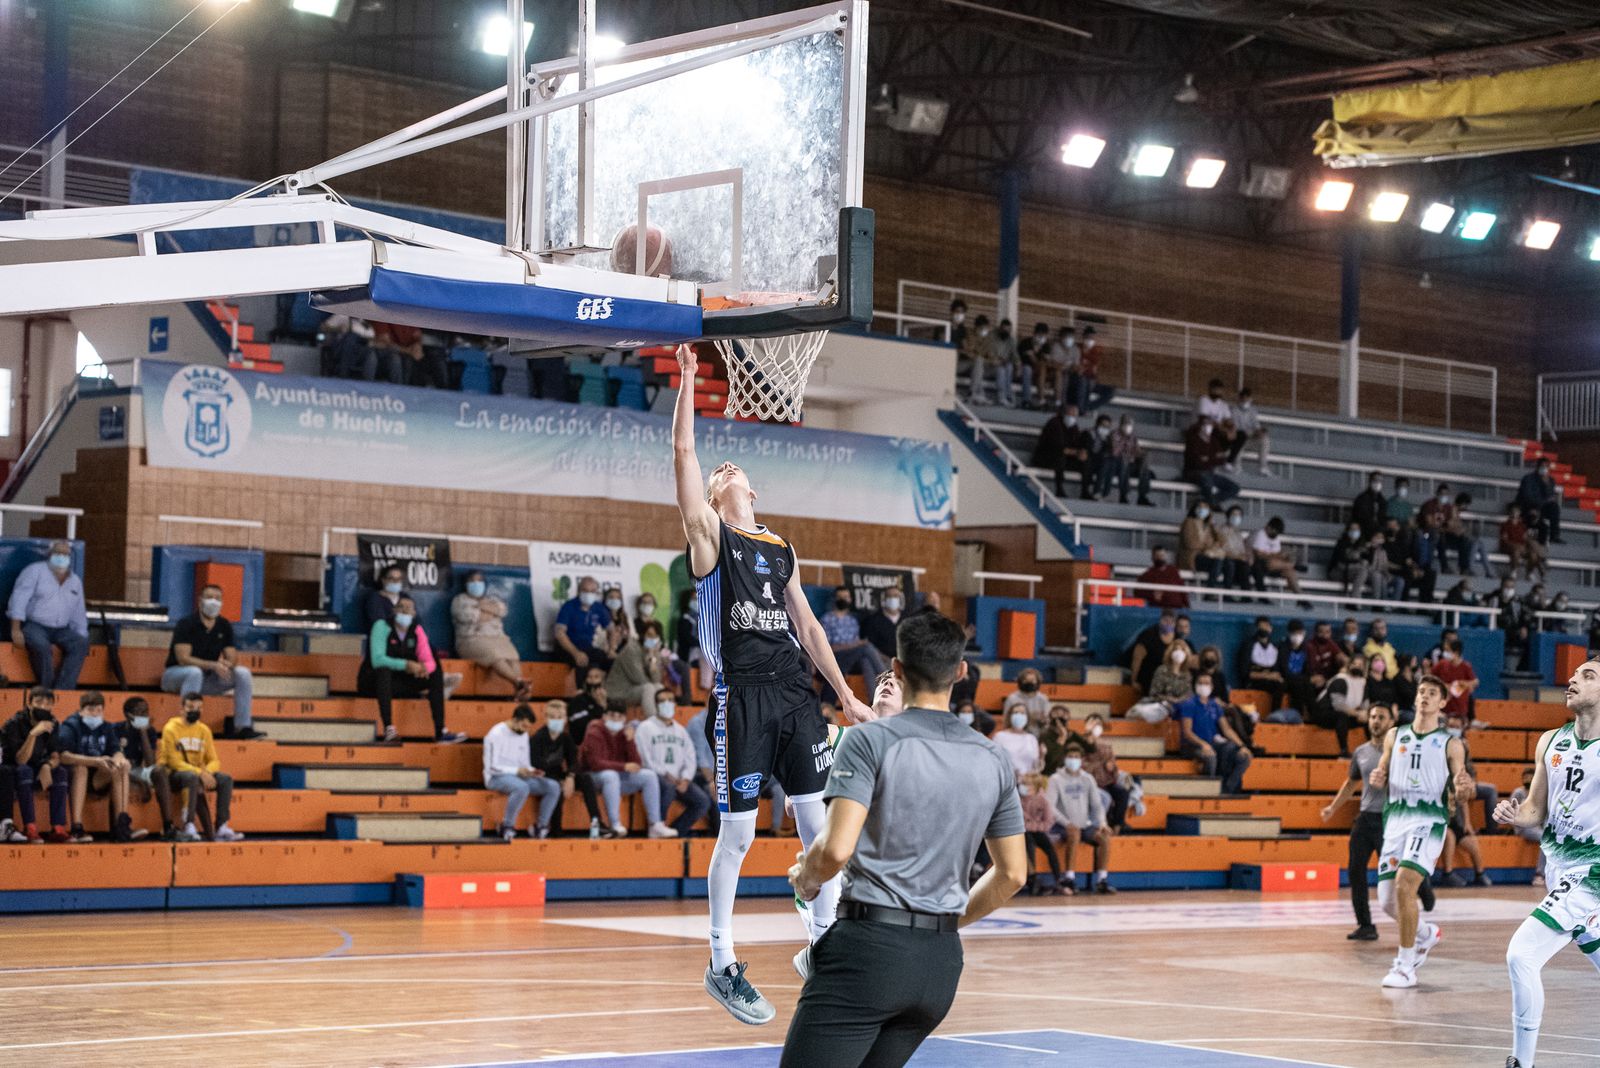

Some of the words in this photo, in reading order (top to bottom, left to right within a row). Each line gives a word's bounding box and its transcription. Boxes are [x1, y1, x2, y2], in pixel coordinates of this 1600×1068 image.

[576, 297, 614, 320] GES
[254, 381, 406, 413] Ayuntamiento
[298, 408, 326, 428] de
[332, 410, 407, 436] Huelva
[454, 401, 494, 429] La
[500, 408, 594, 436] emoción
[600, 412, 624, 439] de
[629, 424, 686, 448] gan
[754, 433, 780, 456] ser
[786, 441, 856, 466] mayor
[548, 551, 621, 568] ASPROMIN
[407, 561, 439, 586] ORO
[759, 619, 772, 629] TE
[716, 735, 728, 804] ENRIQUE
[1411, 753, 1421, 769] 11
[1566, 767, 1585, 793] 12
[1410, 836, 1423, 851] 11
